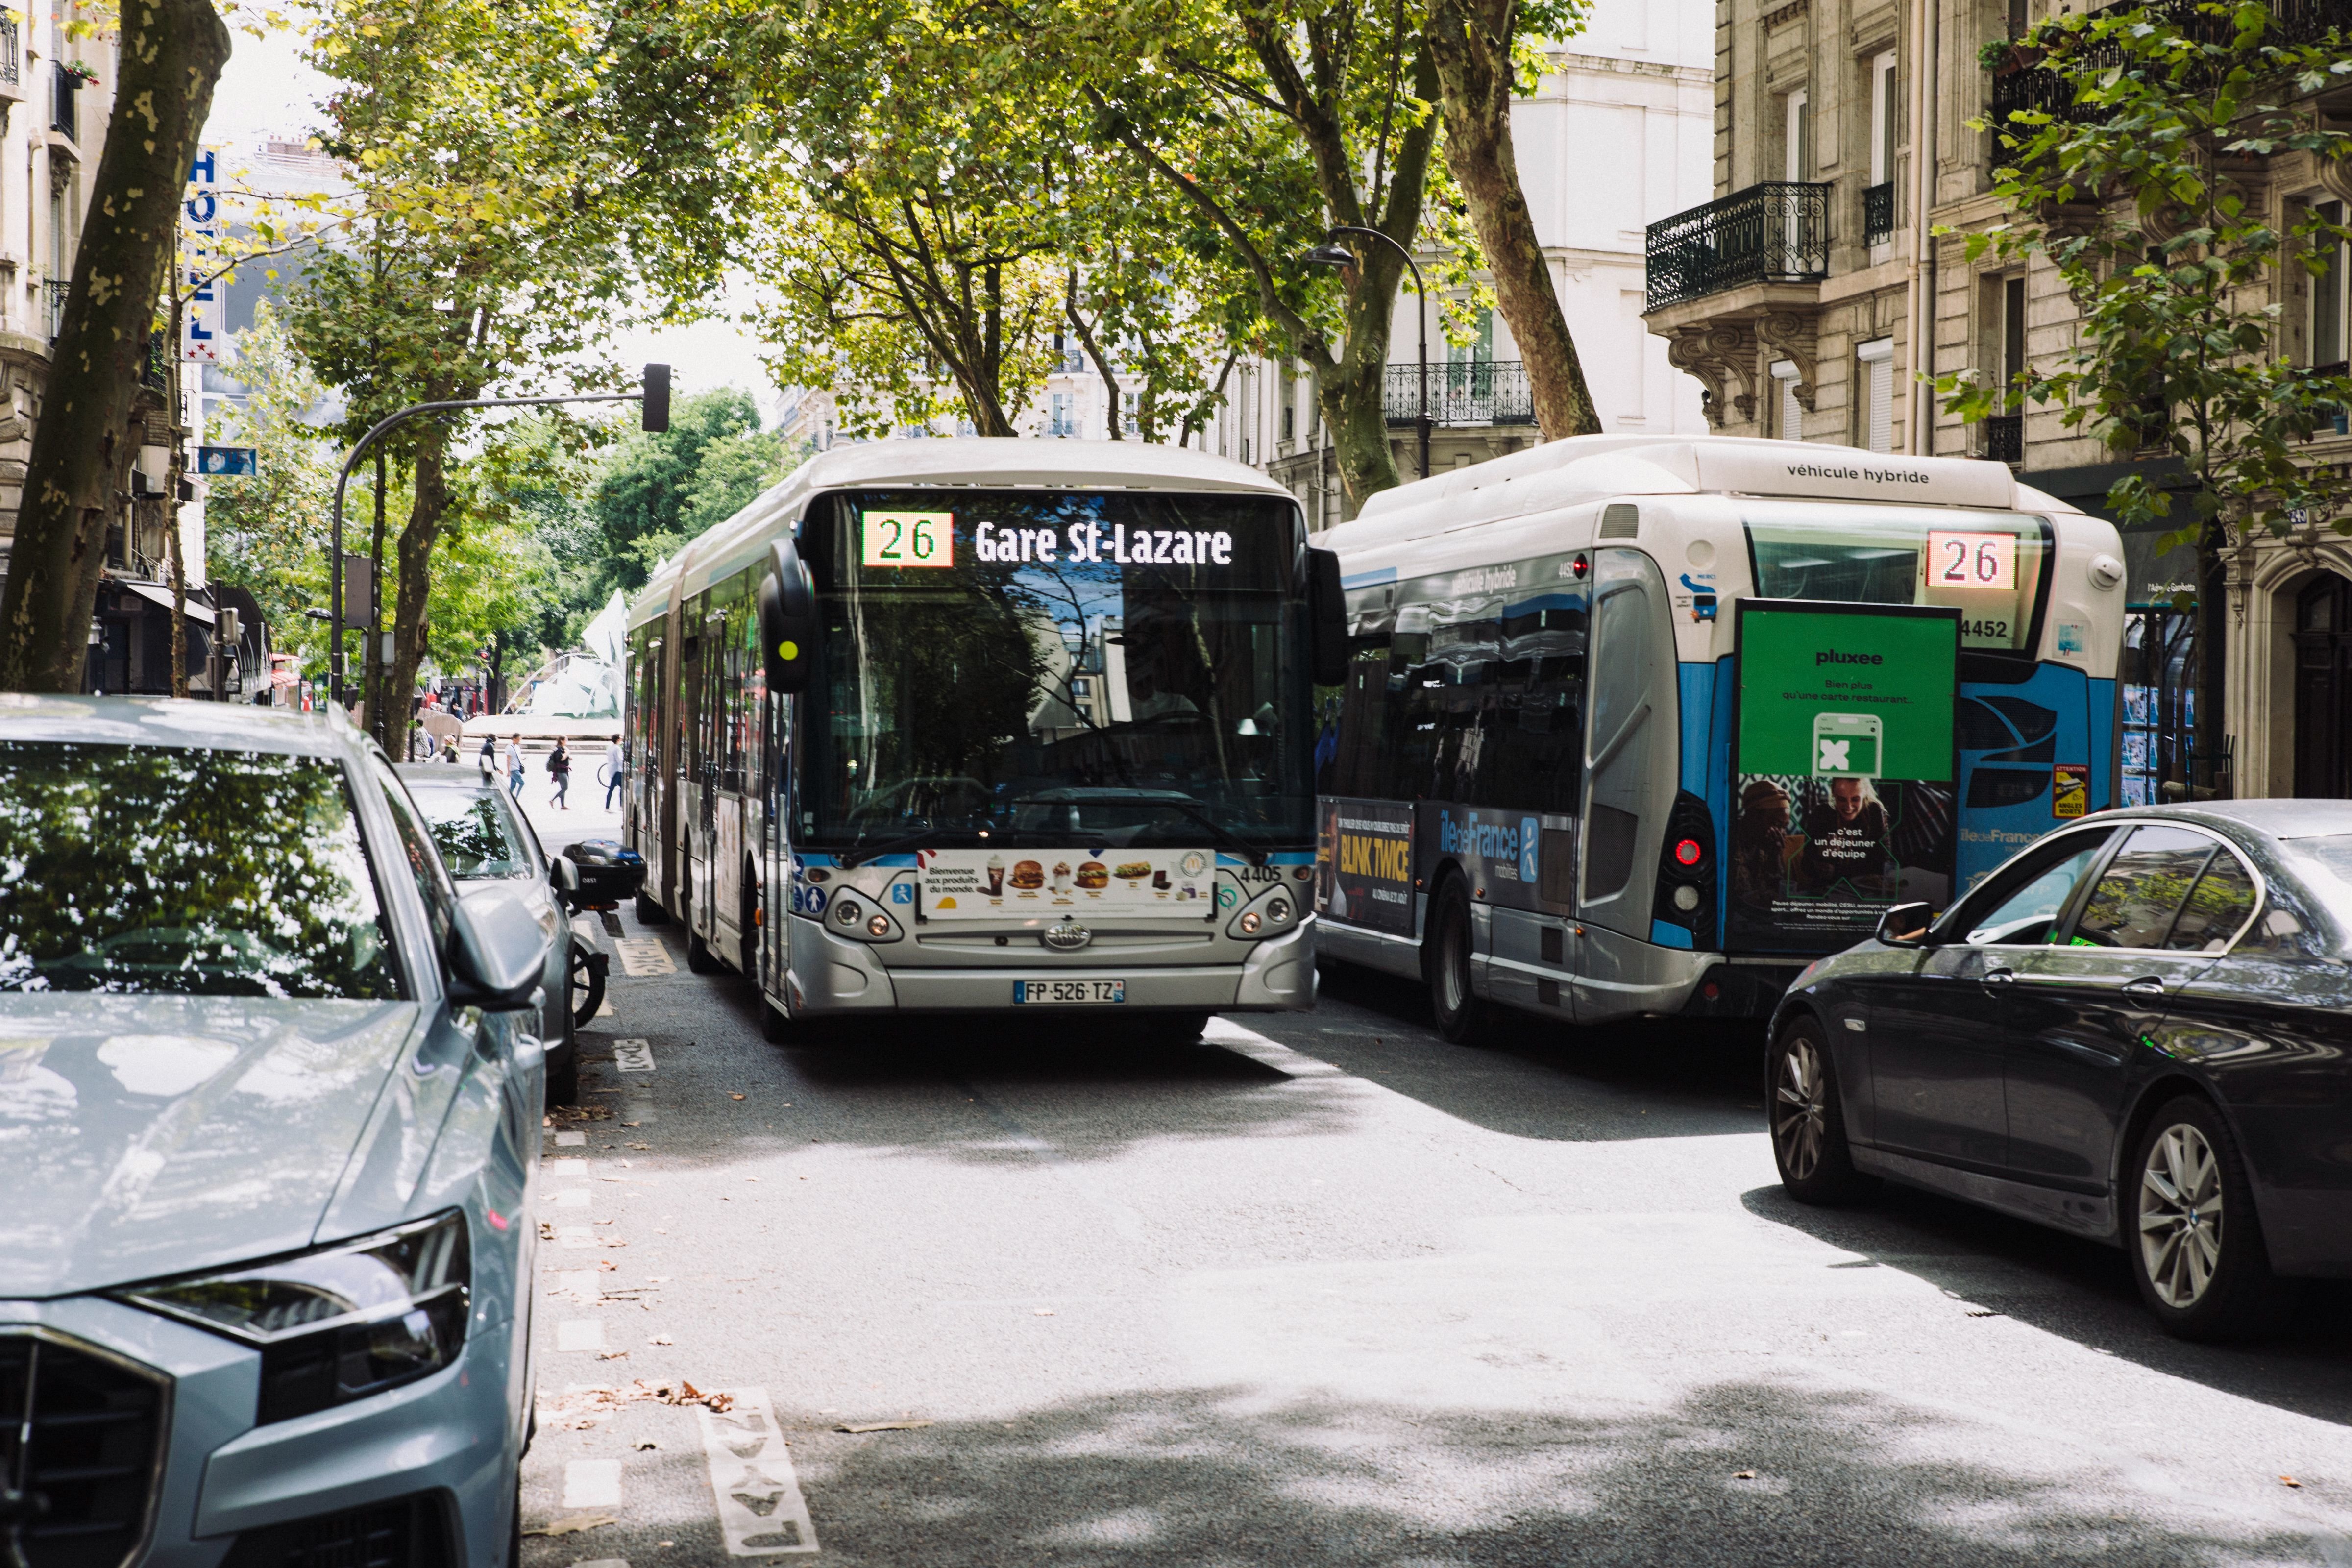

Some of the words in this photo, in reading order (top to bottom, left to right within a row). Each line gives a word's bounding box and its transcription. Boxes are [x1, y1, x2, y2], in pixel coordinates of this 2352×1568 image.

[1787, 464, 1859, 479] véhicule
[1864, 468, 1929, 484] hybride
[879, 519, 934, 559] 26
[976, 521, 1057, 563] Gare
[1068, 521, 1232, 564] St-Lazare
[1944, 539, 1997, 582] 26
[1485, 564, 1516, 594] hybride
[1961, 620, 2007, 637] 4452
[1816, 649, 1883, 666] pluxee
[1825, 679, 1849, 689] Bien
[1851, 681, 1873, 690] plus
[1783, 691, 1818, 701] qu'une
[1821, 693, 1849, 702] carte
[1837, 827, 1862, 836] c'est
[1829, 837, 1876, 849] déjeuner
[1341, 834, 1372, 876] BLINK
[1374, 838, 1409, 882] TWICE
[1822, 848, 1866, 859] d'équipe
[930, 866, 975, 875] Bienvenue
[1240, 866, 1282, 883] 4405
[942, 876, 980, 886] produits
[1026, 982, 1113, 1001] FP-526-TZ
